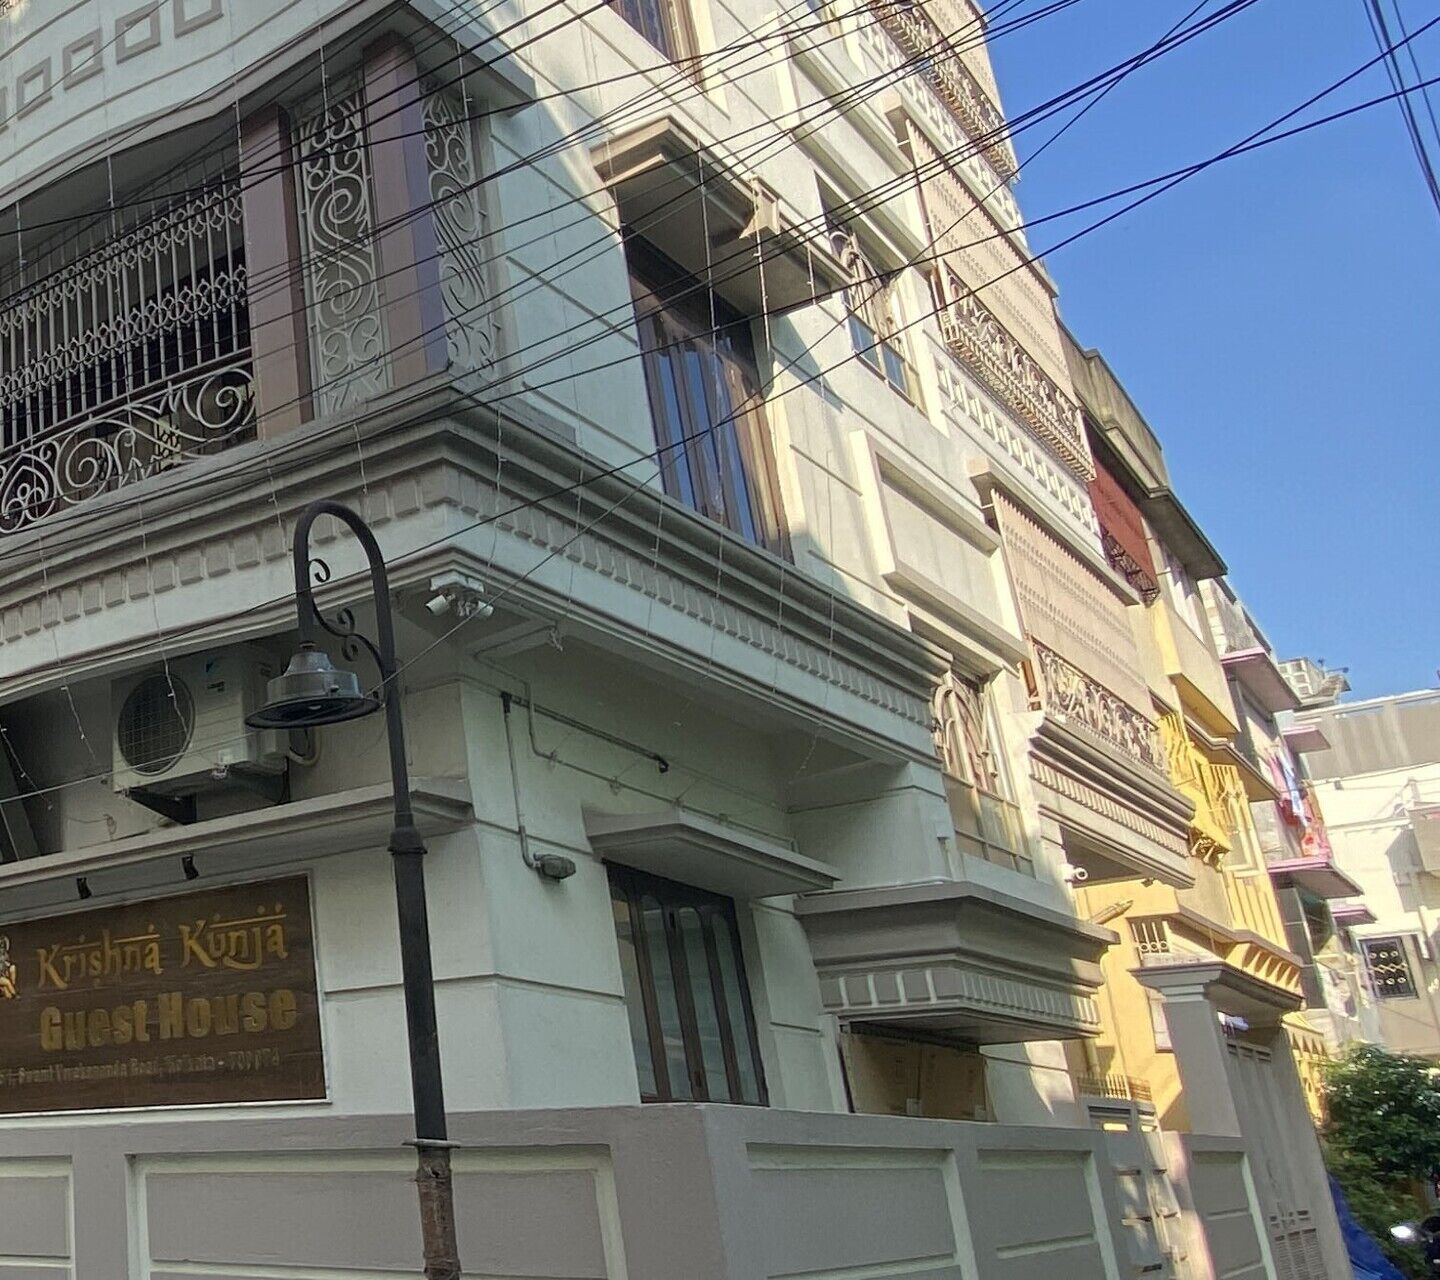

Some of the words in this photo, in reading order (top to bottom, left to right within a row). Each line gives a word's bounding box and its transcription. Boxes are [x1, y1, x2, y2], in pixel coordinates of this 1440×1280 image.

[37, 924, 164, 989] Krishna
[179, 903, 289, 970] Kunja
[40, 1000, 151, 1052] Guest
[158, 989, 297, 1040] House
